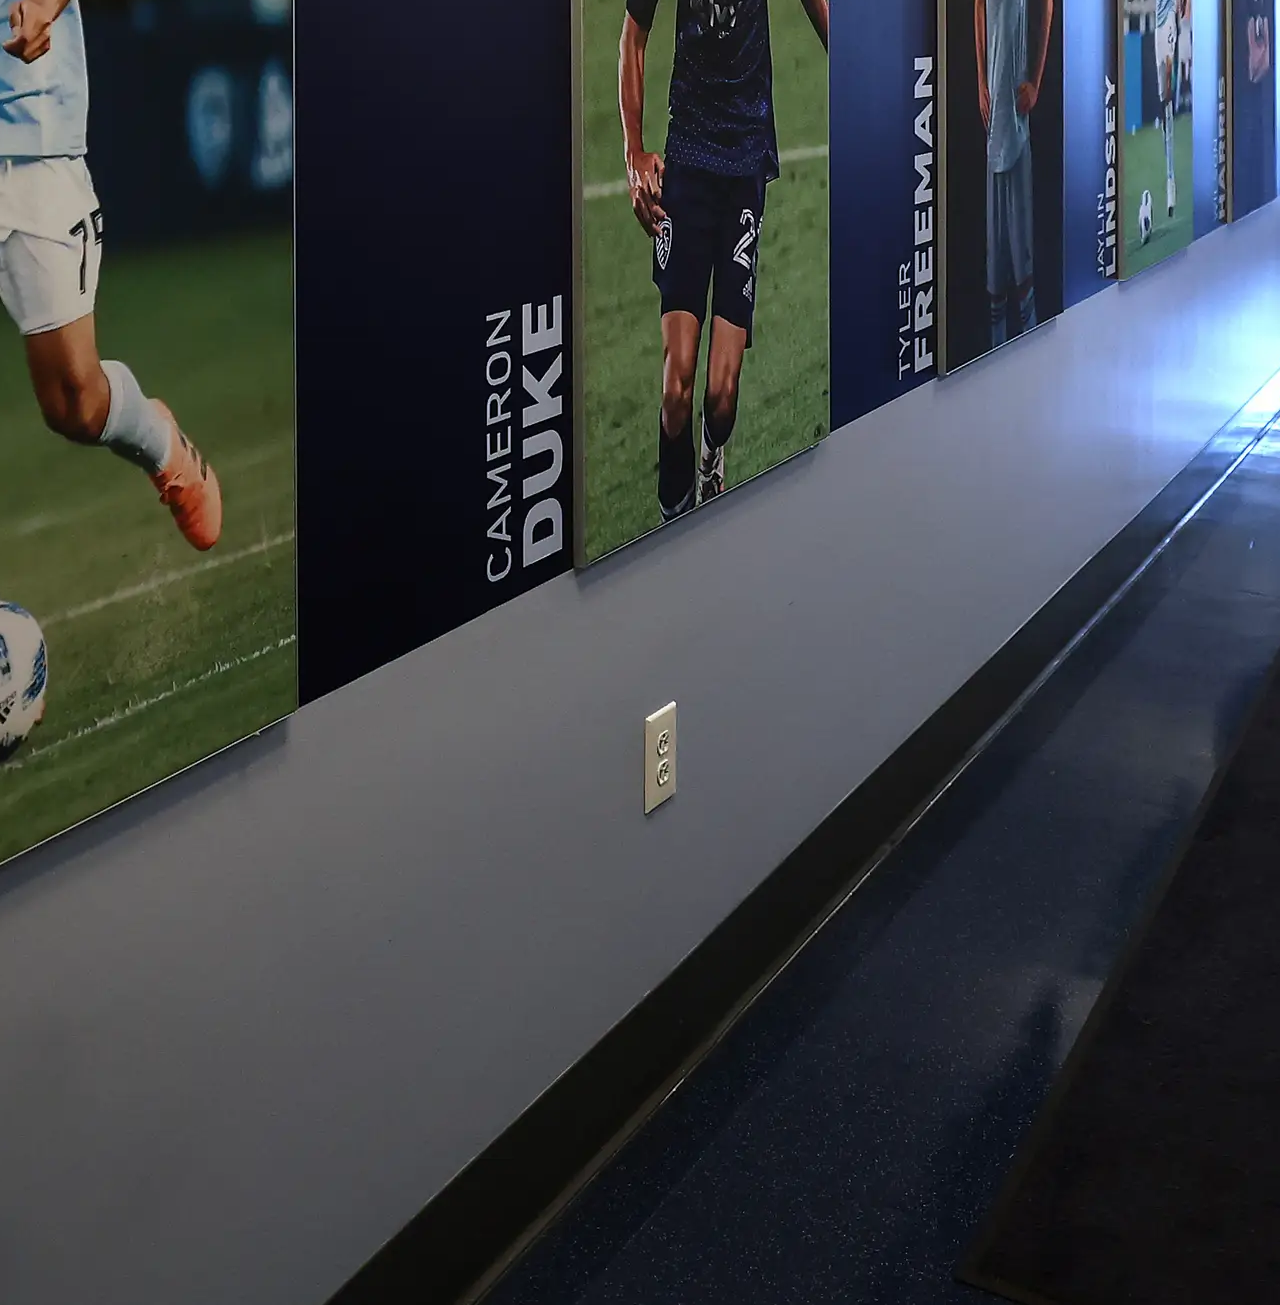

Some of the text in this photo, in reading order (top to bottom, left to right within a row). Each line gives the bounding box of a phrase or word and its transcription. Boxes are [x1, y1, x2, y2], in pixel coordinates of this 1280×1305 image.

[913, 55, 934, 375] FREEMAN
[1096, 192, 1106, 279] JAYLIN
[1105, 74, 1117, 278] LINDSEY
[521, 293, 564, 570] DUKE
[898, 261, 912, 381] TYLER
[485, 308, 512, 584] CAMERON
